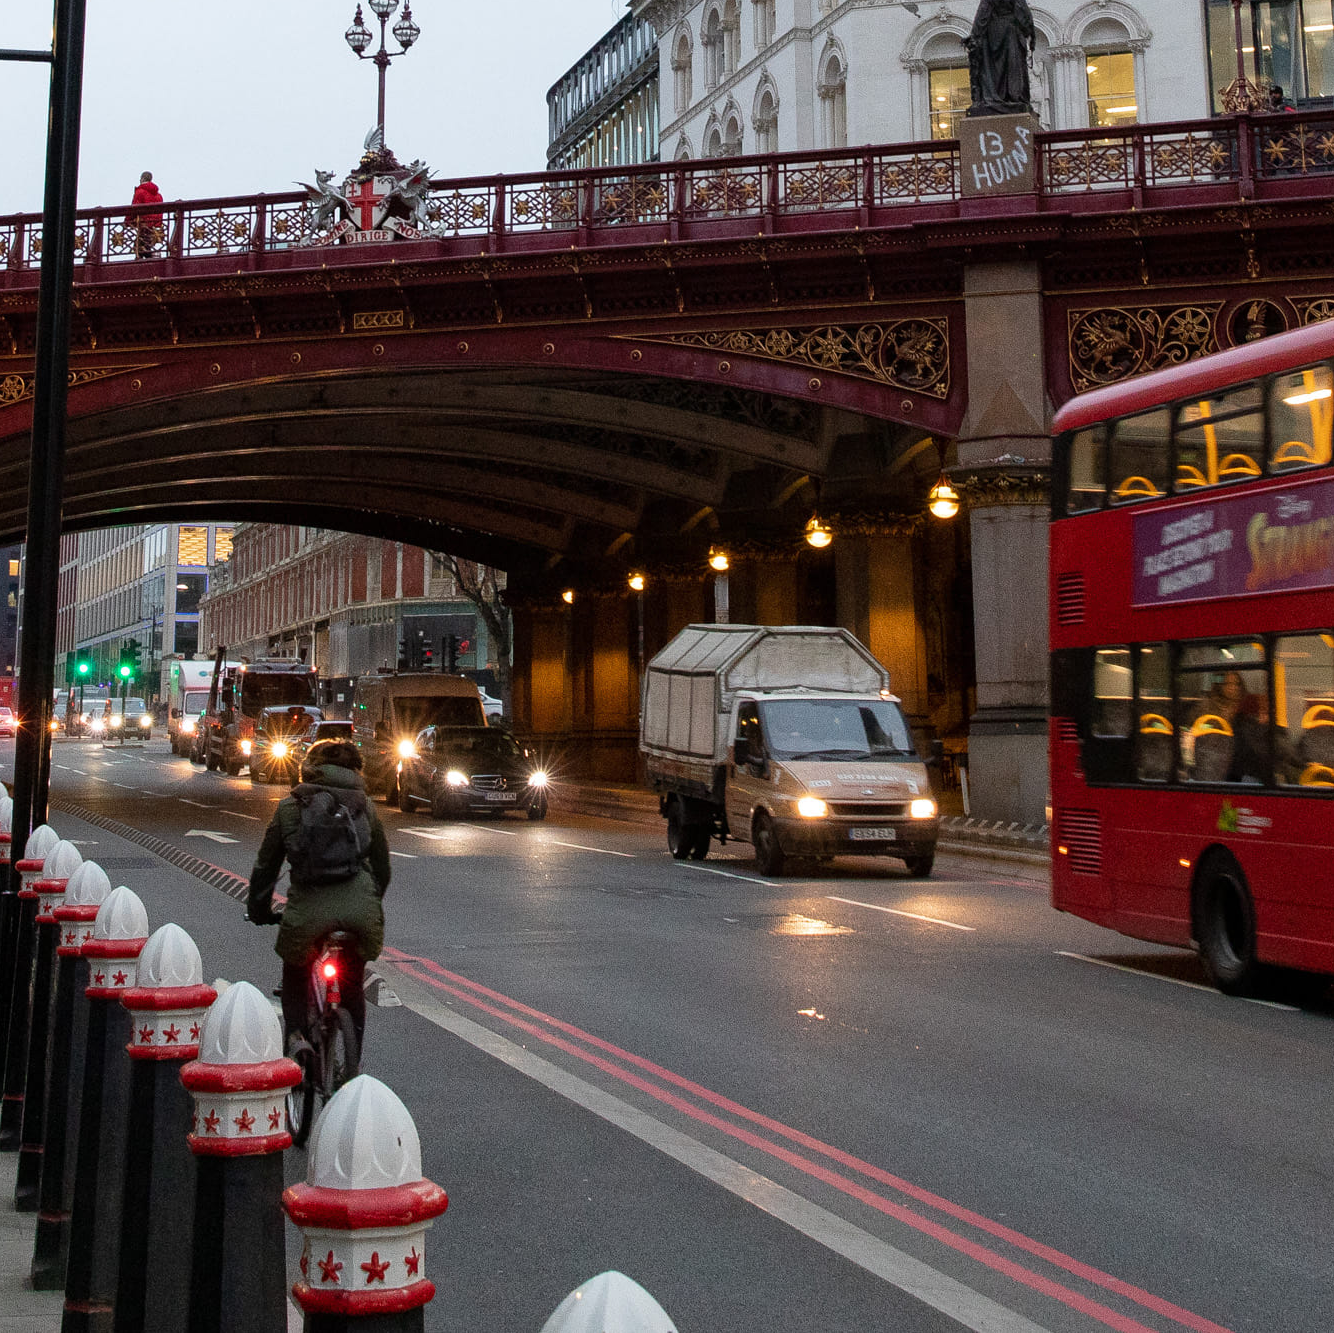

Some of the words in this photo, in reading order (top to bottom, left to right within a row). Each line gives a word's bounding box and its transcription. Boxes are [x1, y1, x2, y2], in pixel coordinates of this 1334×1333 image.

[979, 131, 1004, 156] 13
[346, 230, 388, 244] DIRIGE
[397, 223, 422, 239] NOS
